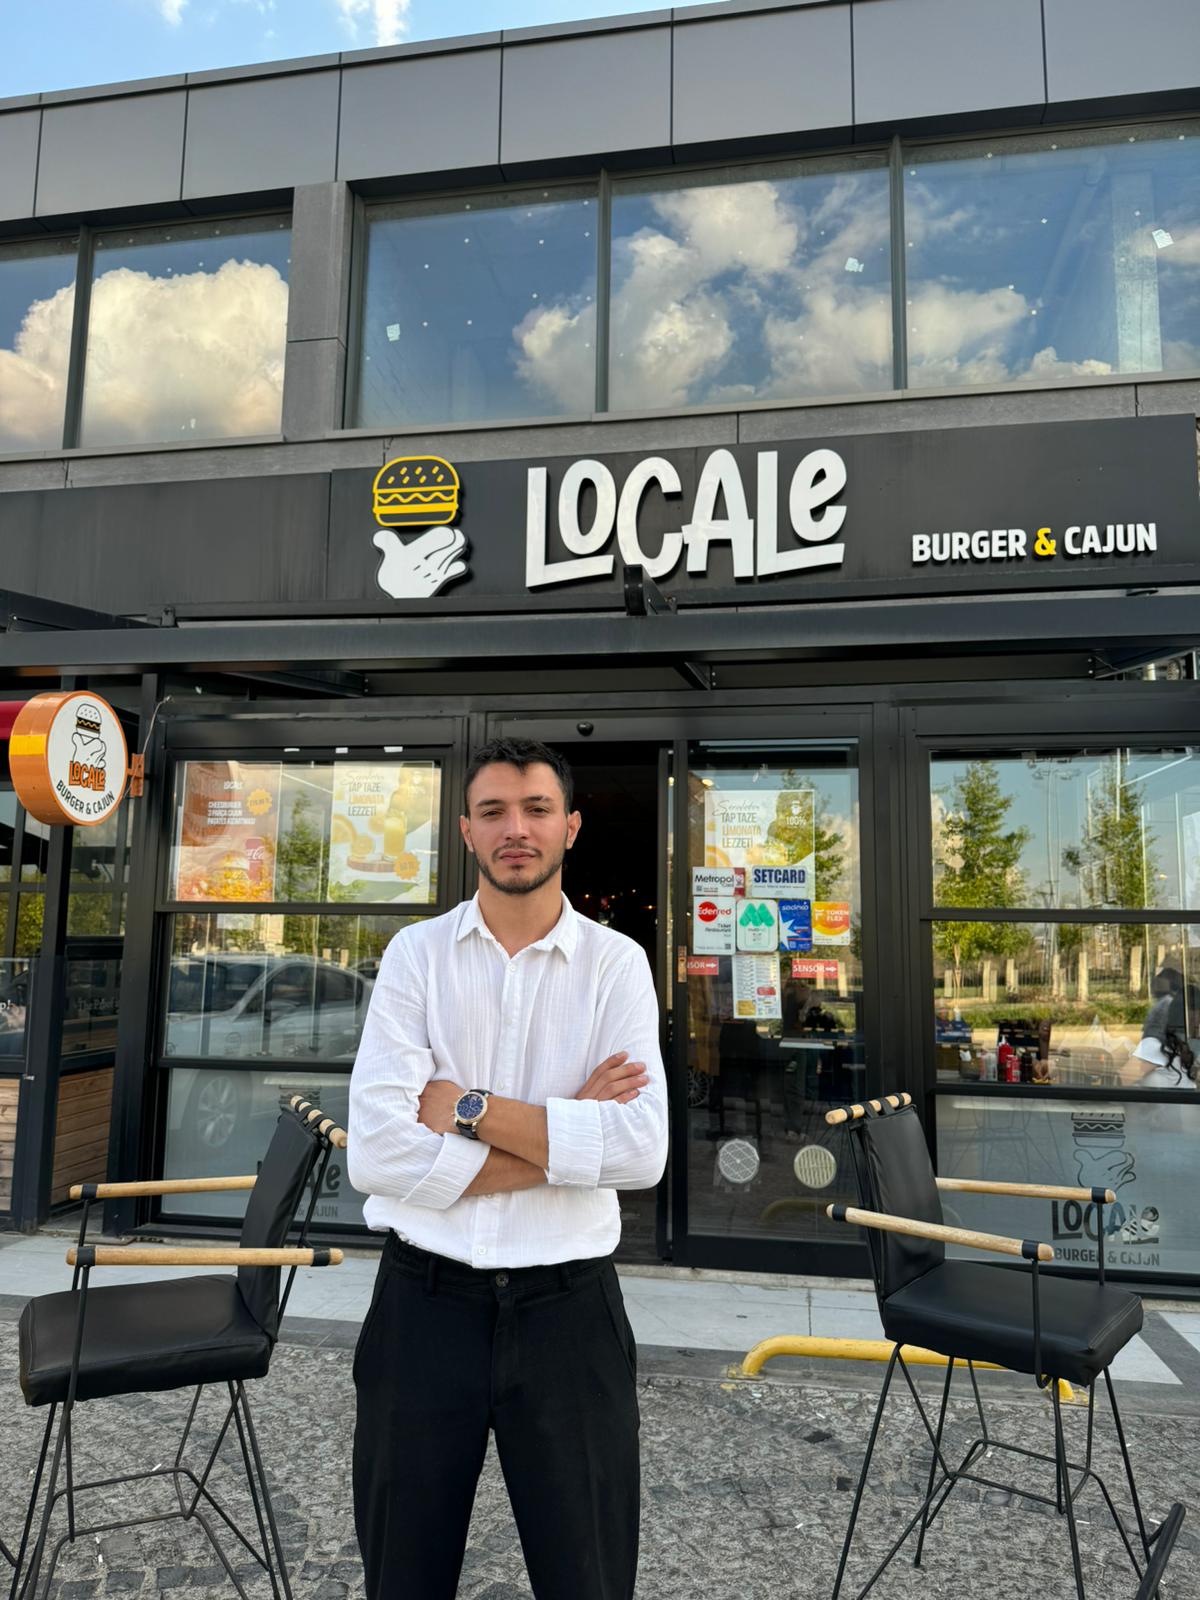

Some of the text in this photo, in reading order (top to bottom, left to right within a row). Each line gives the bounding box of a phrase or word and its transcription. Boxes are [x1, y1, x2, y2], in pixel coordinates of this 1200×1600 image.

[912, 523, 1157, 562] BURGER & CAJUN
[56, 779, 115, 815] BURGER & CAJUN
[721, 813, 758, 823] TAP TAZE
[695, 874, 734, 884] Metropol
[754, 869, 805, 883] SETCARD
[698, 906, 732, 915] Edenred
[793, 964, 824, 973] SENSOR
[1055, 1248, 1100, 1262] BURGE
[1107, 1251, 1117, 1264] &
